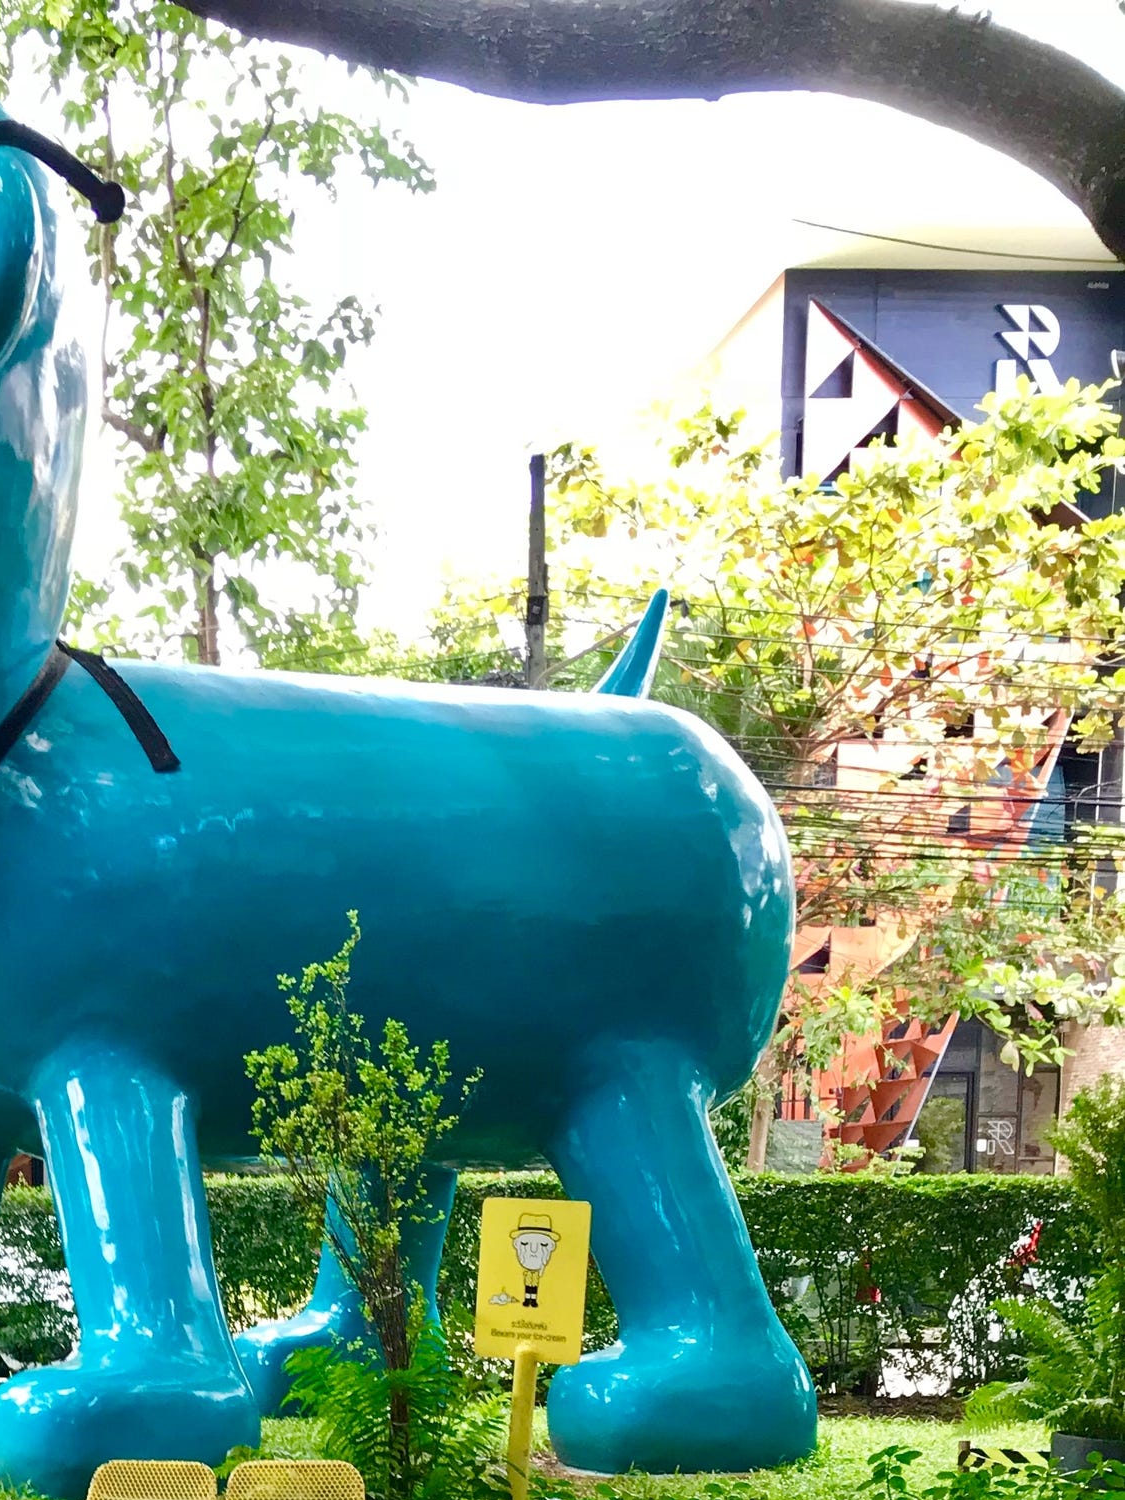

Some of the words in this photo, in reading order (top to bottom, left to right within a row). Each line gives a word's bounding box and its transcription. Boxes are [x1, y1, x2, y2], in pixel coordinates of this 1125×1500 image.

[491, 1328, 515, 1338] Beware
[517, 1332, 532, 1341] your
[533, 1333, 566, 1342] ice-cream
